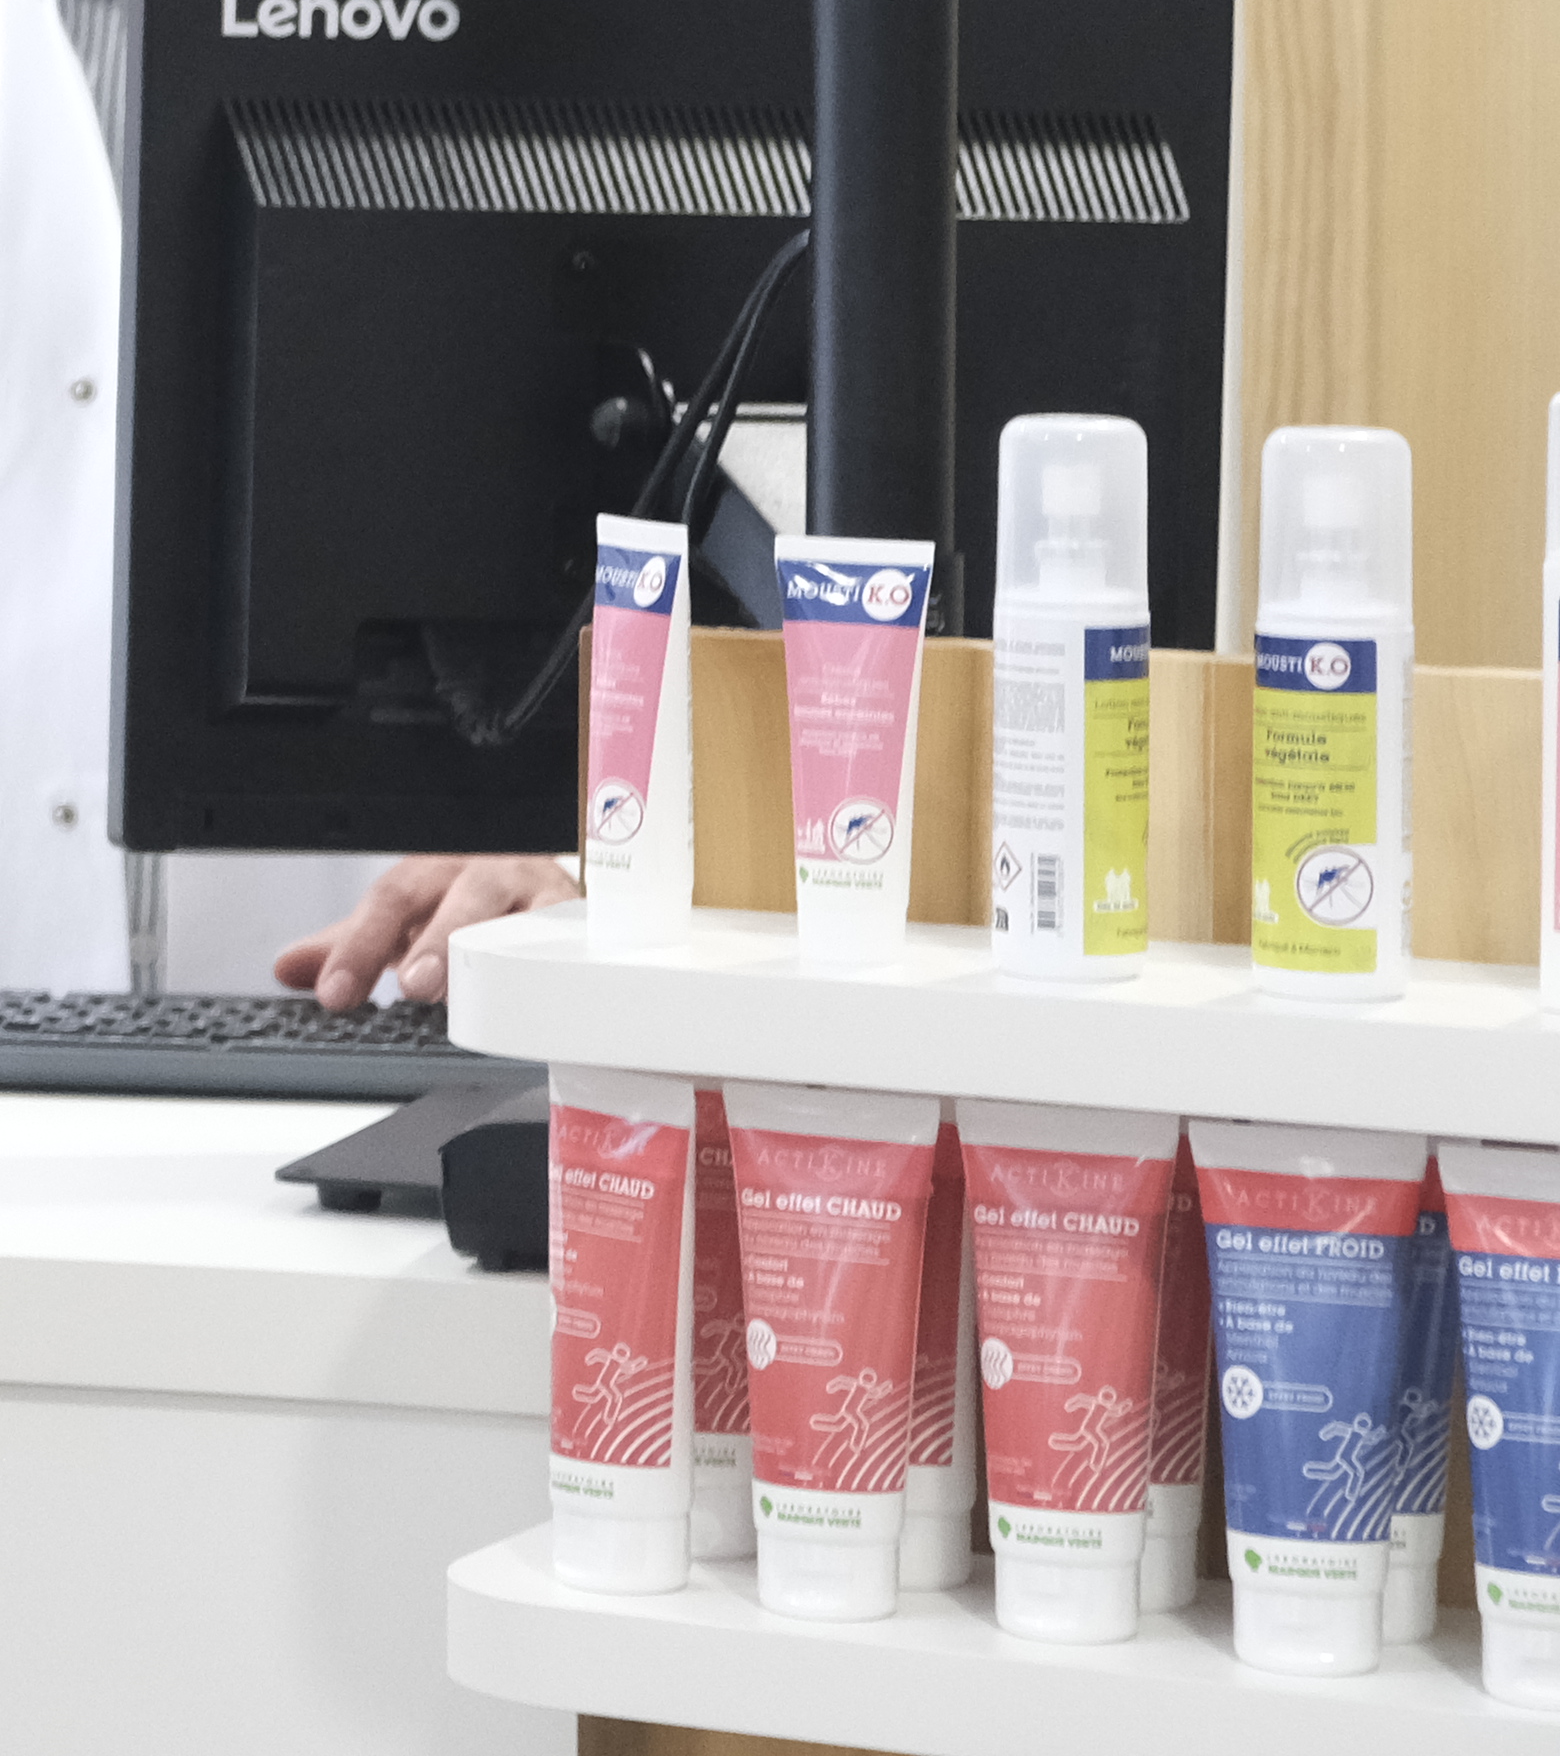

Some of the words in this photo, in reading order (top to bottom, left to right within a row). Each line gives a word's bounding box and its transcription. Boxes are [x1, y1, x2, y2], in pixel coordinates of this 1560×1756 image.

[785, 583, 859, 605] MOUSTI
[867, 583, 910, 607] K.O
[1309, 655, 1350, 676] K.O
[1266, 728, 1328, 745] Formule
[1265, 747, 1331, 765] végétale
[757, 1145, 887, 1182] ACTIKINE
[564, 1168, 596, 1188] effet
[598, 1173, 655, 1201] CHAUD
[991, 1159, 1123, 1197] ACTIKINE
[741, 1187, 771, 1210] Gel
[775, 1191, 822, 1213] effet
[826, 1196, 903, 1223] CHAUD
[1237, 1186, 1379, 1222] ACTIKINE
[973, 1204, 1005, 1226] Gel
[1010, 1207, 1058, 1231] effet
[1063, 1212, 1141, 1238] CHAUD
[1216, 1229, 1253, 1251] Gel
[1258, 1233, 1309, 1255] effet
[1315, 1236, 1385, 1260] FROID
[1458, 1254, 1492, 1277] Gel
[1498, 1259, 1551, 1284] effet
[756, 1271, 785, 1288] base
[787, 1276, 804, 1290] de
[991, 1288, 1021, 1305] base
[1023, 1292, 1041, 1307] de
[1238, 1316, 1271, 1332] base
[1274, 1320, 1294, 1334] de
[1479, 1345, 1511, 1362] base
[1514, 1349, 1534, 1364] de
[776, 1502, 861, 1518] LABORATOIRE
[777, 1512, 824, 1526] MARQUE
[827, 1517, 861, 1529] VERTE
[1016, 1523, 1102, 1538] LABORATOIRE
[1016, 1533, 1065, 1547] MARQUE
[1068, 1538, 1103, 1550] VERTE
[1267, 1554, 1357, 1568] LABORATOIRE
[1268, 1564, 1321, 1578] MARQUE
[1323, 1568, 1357, 1580] VERTE
